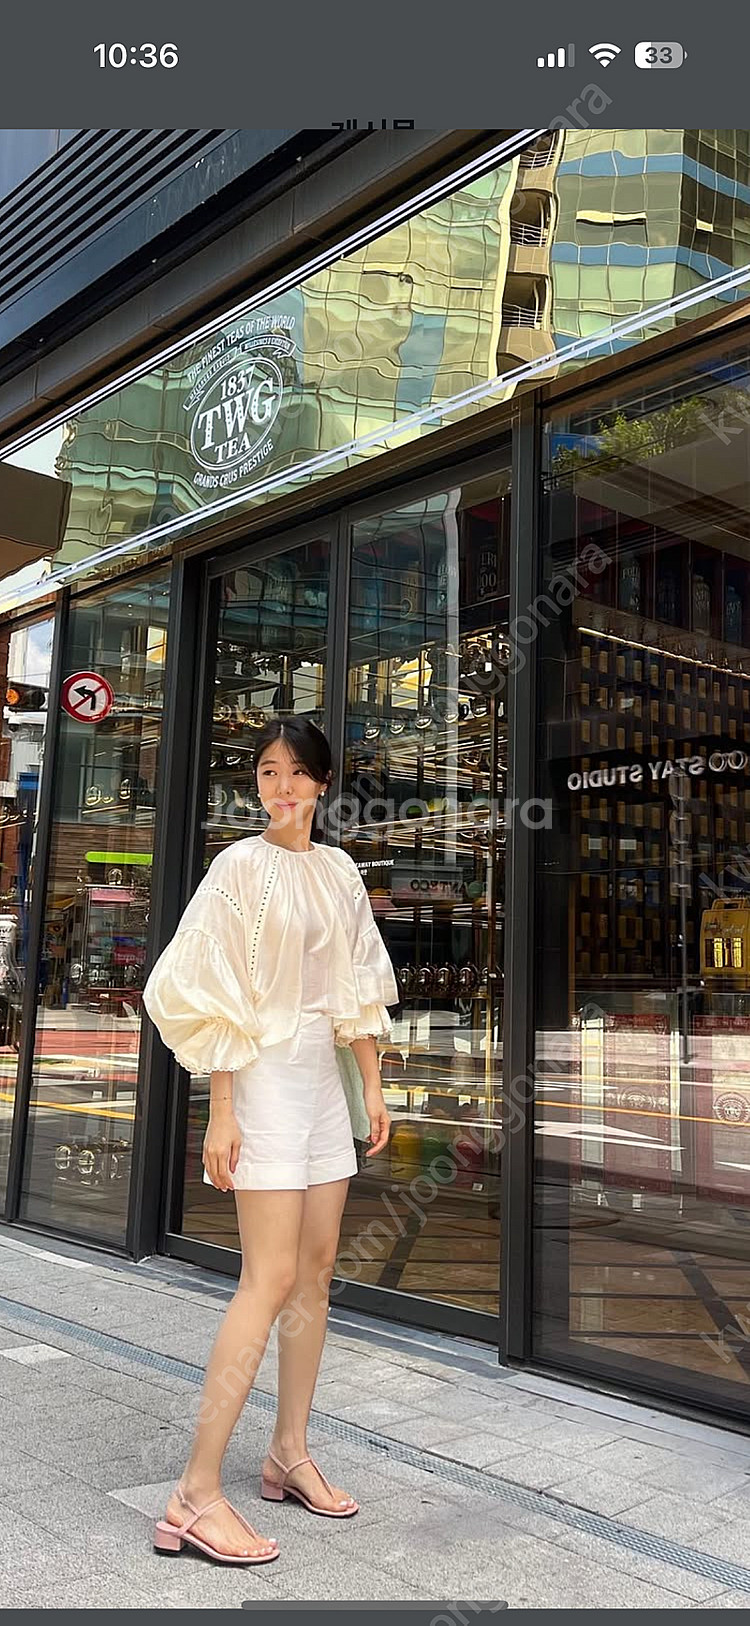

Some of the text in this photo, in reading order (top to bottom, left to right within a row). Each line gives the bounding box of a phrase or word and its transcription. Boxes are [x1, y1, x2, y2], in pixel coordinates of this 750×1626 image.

[93, 43, 179, 69] 10:36
[644, 46, 674, 66] 33
[187, 362, 202, 383] THE
[201, 340, 227, 369] FINEST
[226, 325, 245, 348] TEAS
[245, 322, 257, 338] OF
[256, 316, 270, 331] THE
[271, 315, 296, 330] WORLD
[220, 363, 256, 400] 1837
[198, 377, 277, 451] TWG
[193, 439, 274, 489] GRANDS CRUS PRESTIGE
[214, 432, 252, 464] TEA
